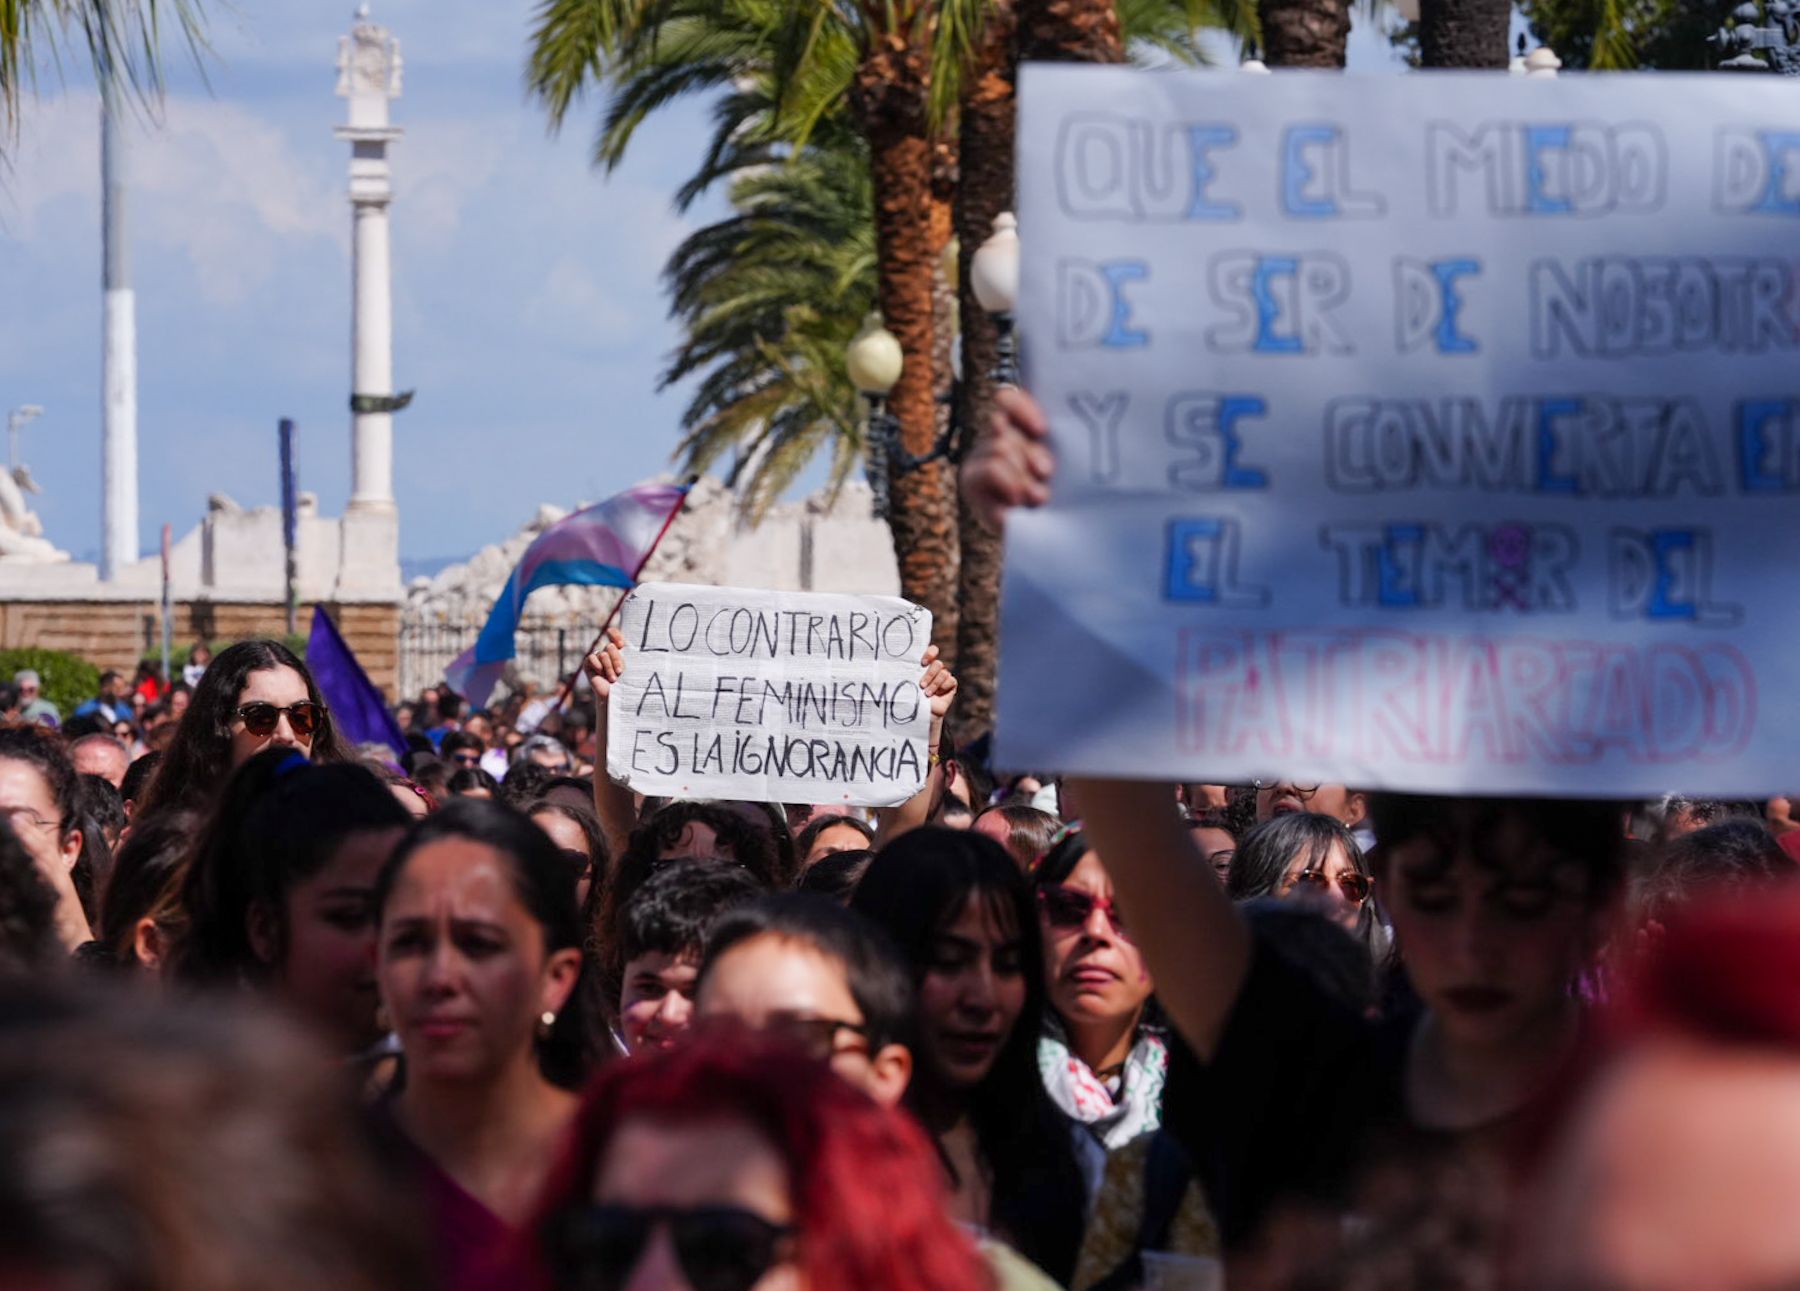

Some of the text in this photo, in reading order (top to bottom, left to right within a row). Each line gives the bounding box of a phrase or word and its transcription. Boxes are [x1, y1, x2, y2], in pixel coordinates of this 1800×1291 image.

[1054, 110, 1243, 222] QUE
[1280, 119, 1388, 220] EL
[1425, 118, 1667, 219] MIEDO
[1056, 256, 1152, 350] DE
[1203, 248, 1355, 357] SER
[1394, 254, 1481, 355] DE
[1067, 390, 1800, 496] Y SE CONVIERTA E
[1162, 516, 1273, 608] EL
[1608, 525, 1744, 628] DEL
[639, 599, 915, 662] LO CONTRARIO
[636, 671, 920, 729] AL FEMINISMO
[1174, 624, 1759, 767] PATRIARCADO
[631, 729, 922, 784] ES LA IGNORANCIA
